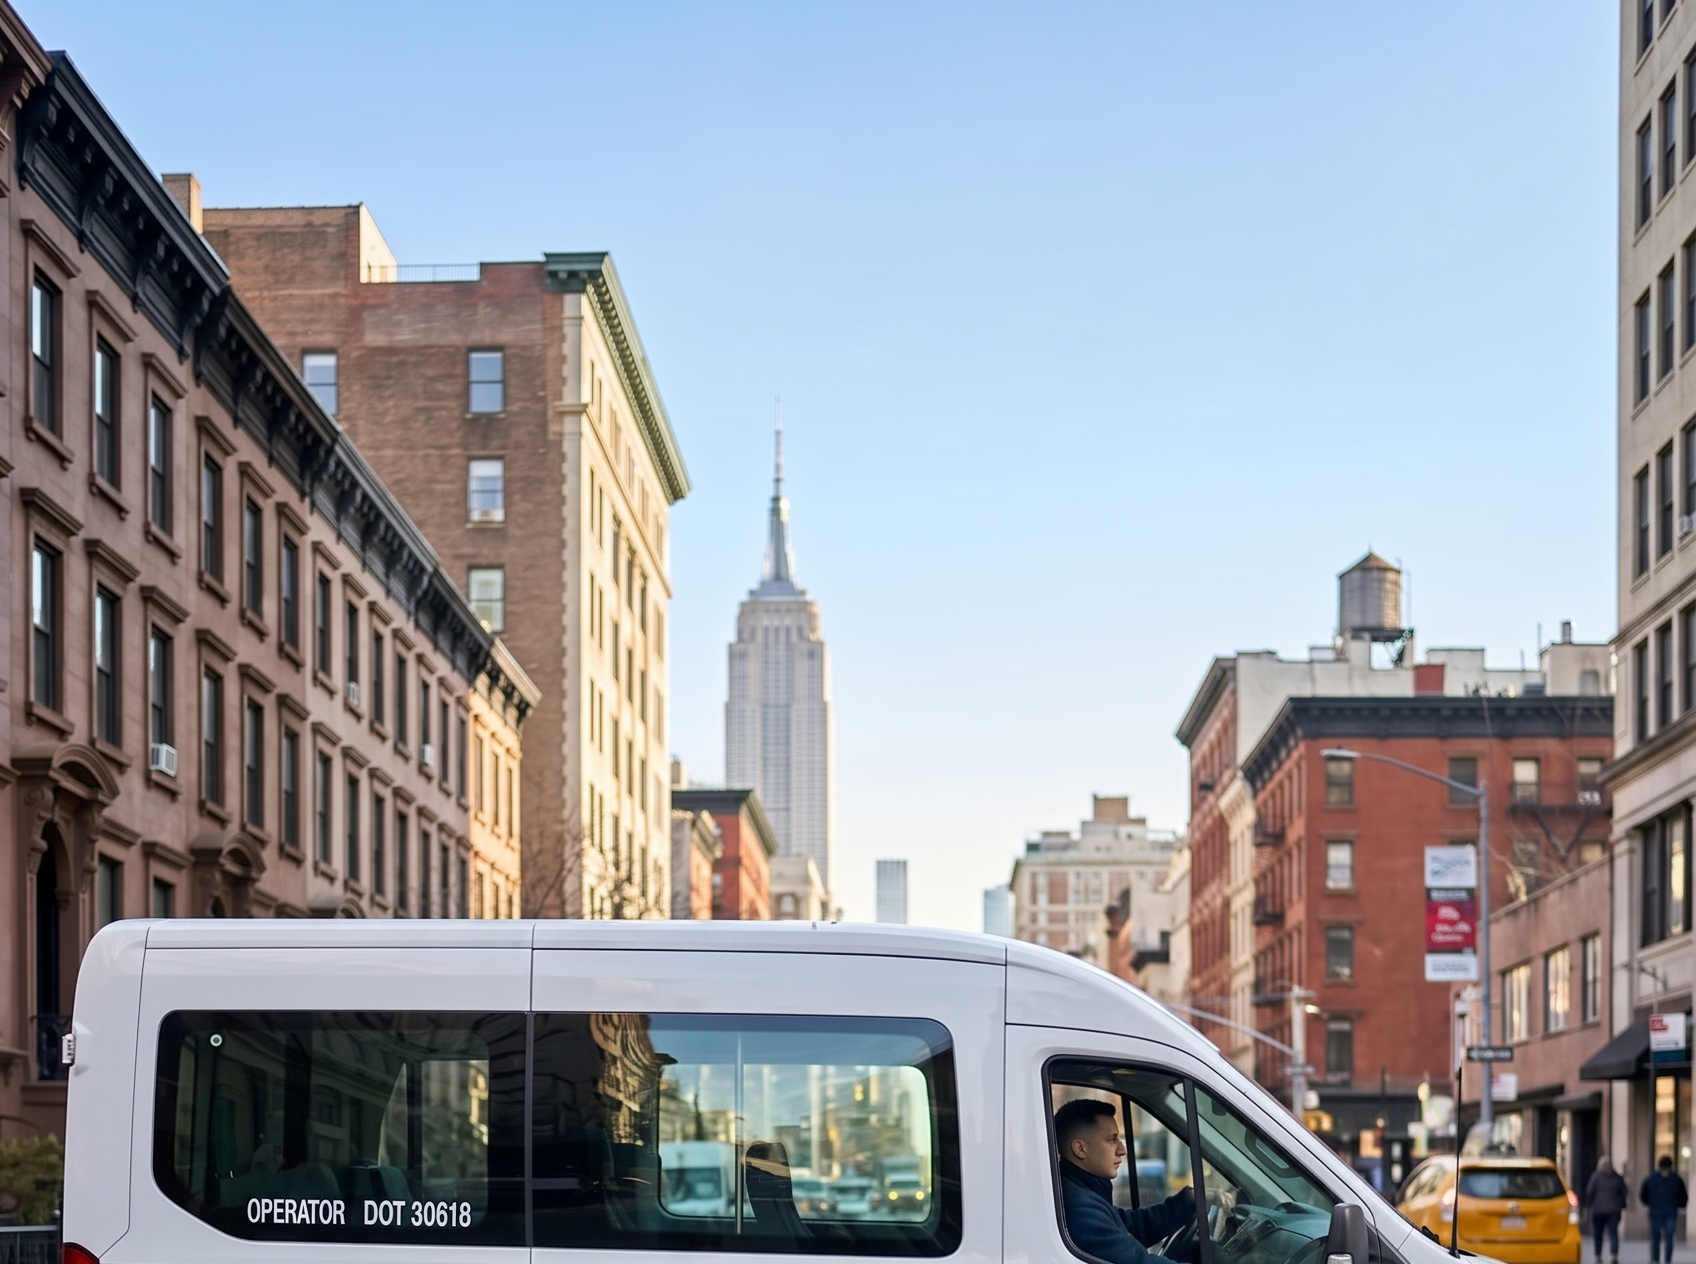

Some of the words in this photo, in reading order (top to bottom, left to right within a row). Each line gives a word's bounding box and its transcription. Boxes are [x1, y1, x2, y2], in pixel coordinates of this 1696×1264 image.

[247, 1198, 345, 1226] OPERATOR
[363, 1200, 405, 1226] DOT
[411, 1201, 472, 1228] 30618
